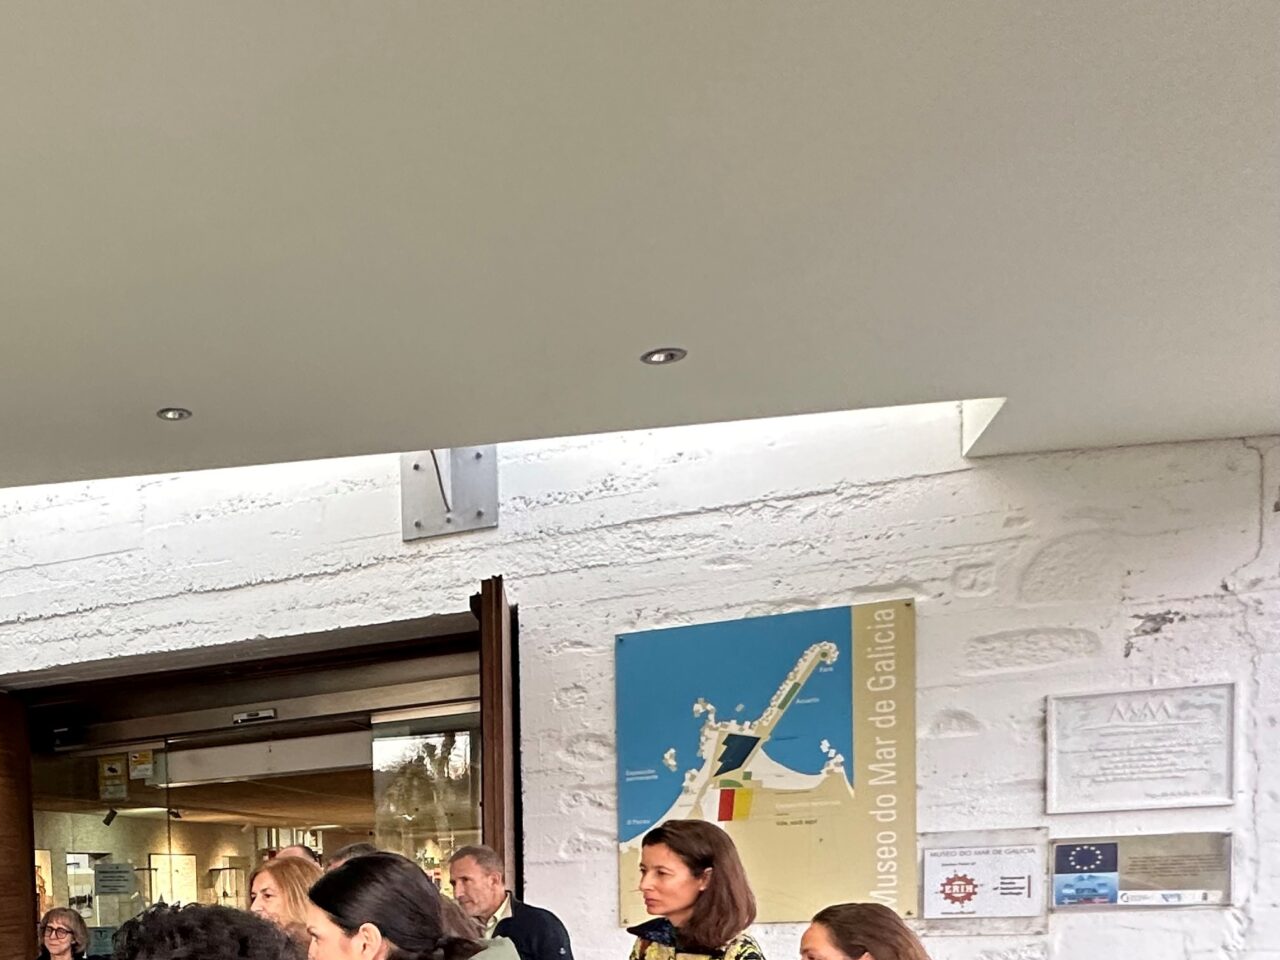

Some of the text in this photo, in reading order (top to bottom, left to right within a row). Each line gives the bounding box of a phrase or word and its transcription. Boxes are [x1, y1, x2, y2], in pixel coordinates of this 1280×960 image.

[866, 608, 898, 911] Museo do Mar de Galicia
[930, 849, 957, 858] MUSEO
[959, 849, 972, 857] DO
[1004, 847, 1036, 855] GALICIA
[944, 884, 974, 893] ERIH
